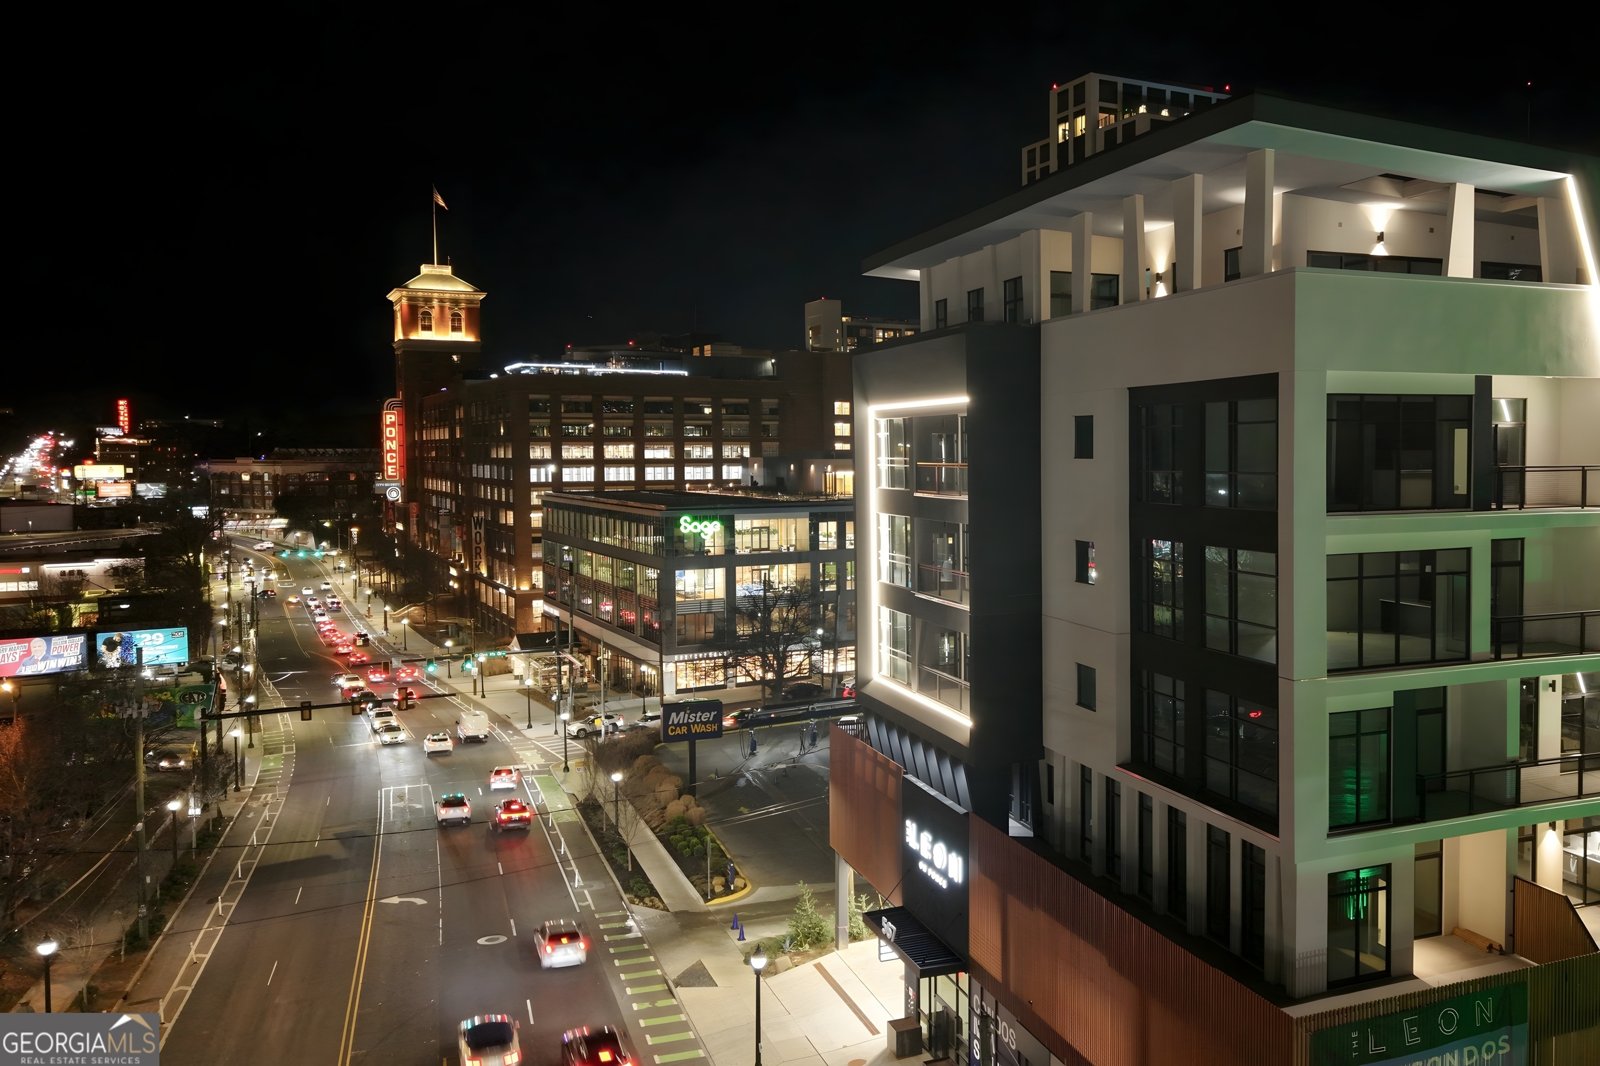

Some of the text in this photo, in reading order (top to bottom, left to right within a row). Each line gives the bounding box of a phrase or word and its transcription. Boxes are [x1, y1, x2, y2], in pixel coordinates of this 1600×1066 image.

[386, 415, 397, 476] PONCE
[472, 517, 484, 573] WORK
[52, 643, 80, 655] POWER
[668, 723, 718, 736] CAR WASH
[669, 707, 717, 725] Mister
[908, 822, 963, 884] LEON
[881, 916, 897, 943] 567
[1350, 997, 1494, 1059] THE LEON
[1409, 1034, 1512, 1066] NDOS
